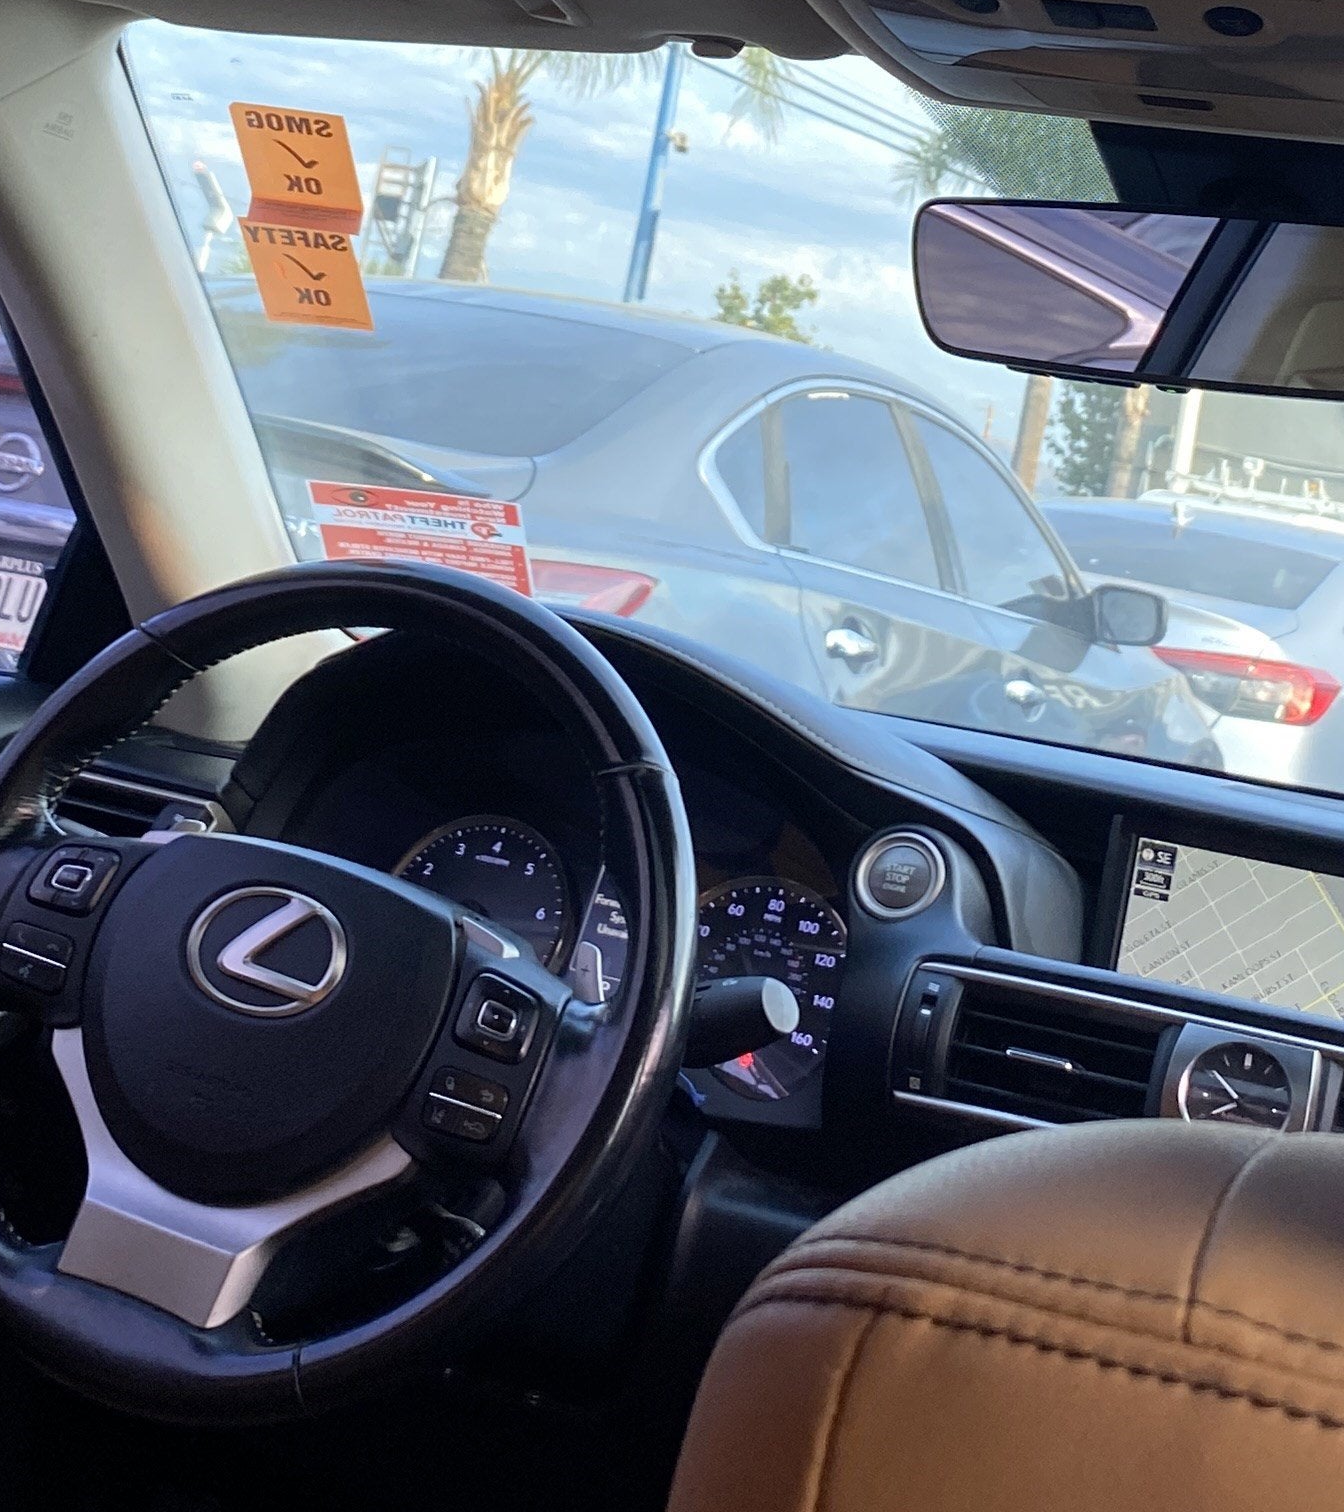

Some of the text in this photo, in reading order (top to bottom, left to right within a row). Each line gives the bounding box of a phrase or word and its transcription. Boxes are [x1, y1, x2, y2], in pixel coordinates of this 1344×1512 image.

[455, 843, 466, 856] 3
[1156, 851, 1173, 864] SE
[422, 862, 434, 875] 2
[524, 862, 535, 875] 5
[727, 903, 745, 917] 60
[768, 898, 785, 912] 80
[535, 907, 546, 920] 6
[798, 920, 820, 935] 100
[815, 953, 836, 968] 120
[813, 994, 835, 1009] 140
[790, 1031, 813, 1046] 160
